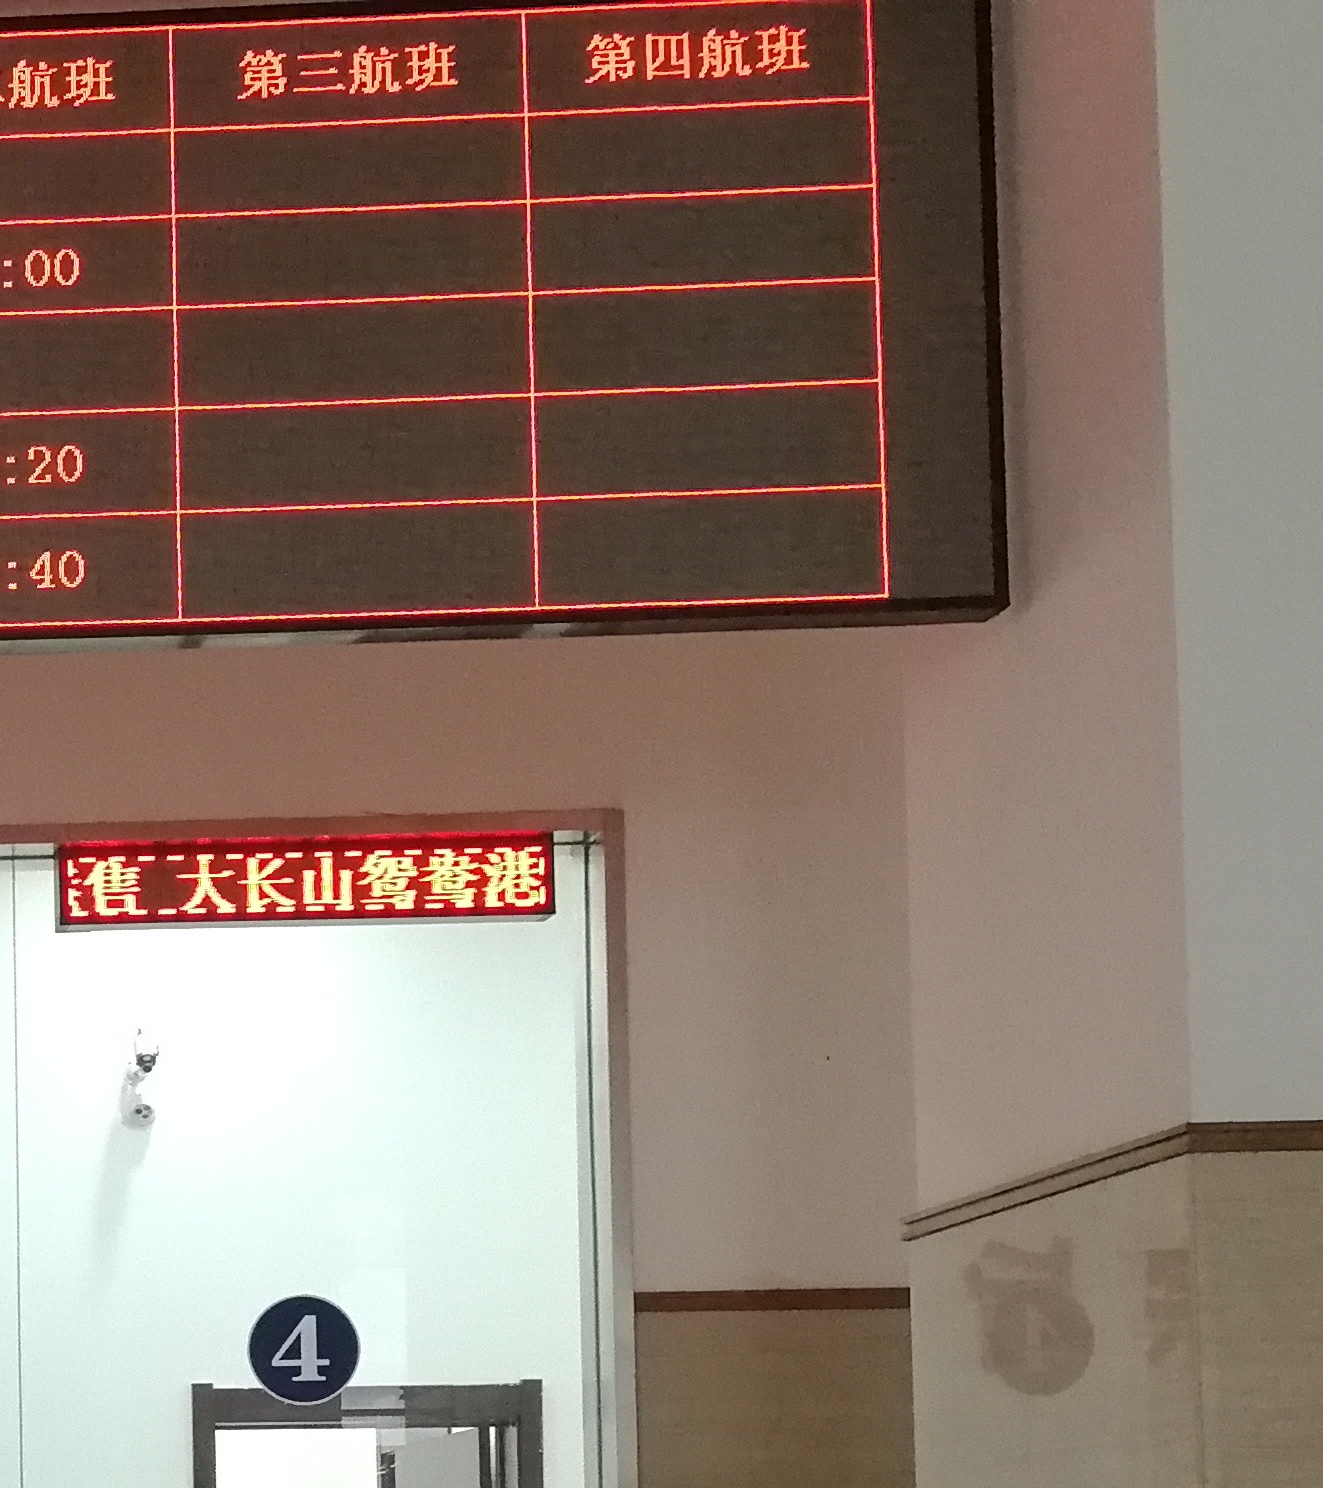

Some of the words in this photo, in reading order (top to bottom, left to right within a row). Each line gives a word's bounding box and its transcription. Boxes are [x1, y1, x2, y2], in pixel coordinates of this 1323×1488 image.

[236, 40, 459, 101] 第三航班
[583, 24, 811, 85] 第四航班
[270, 1314, 331, 1382] 4
